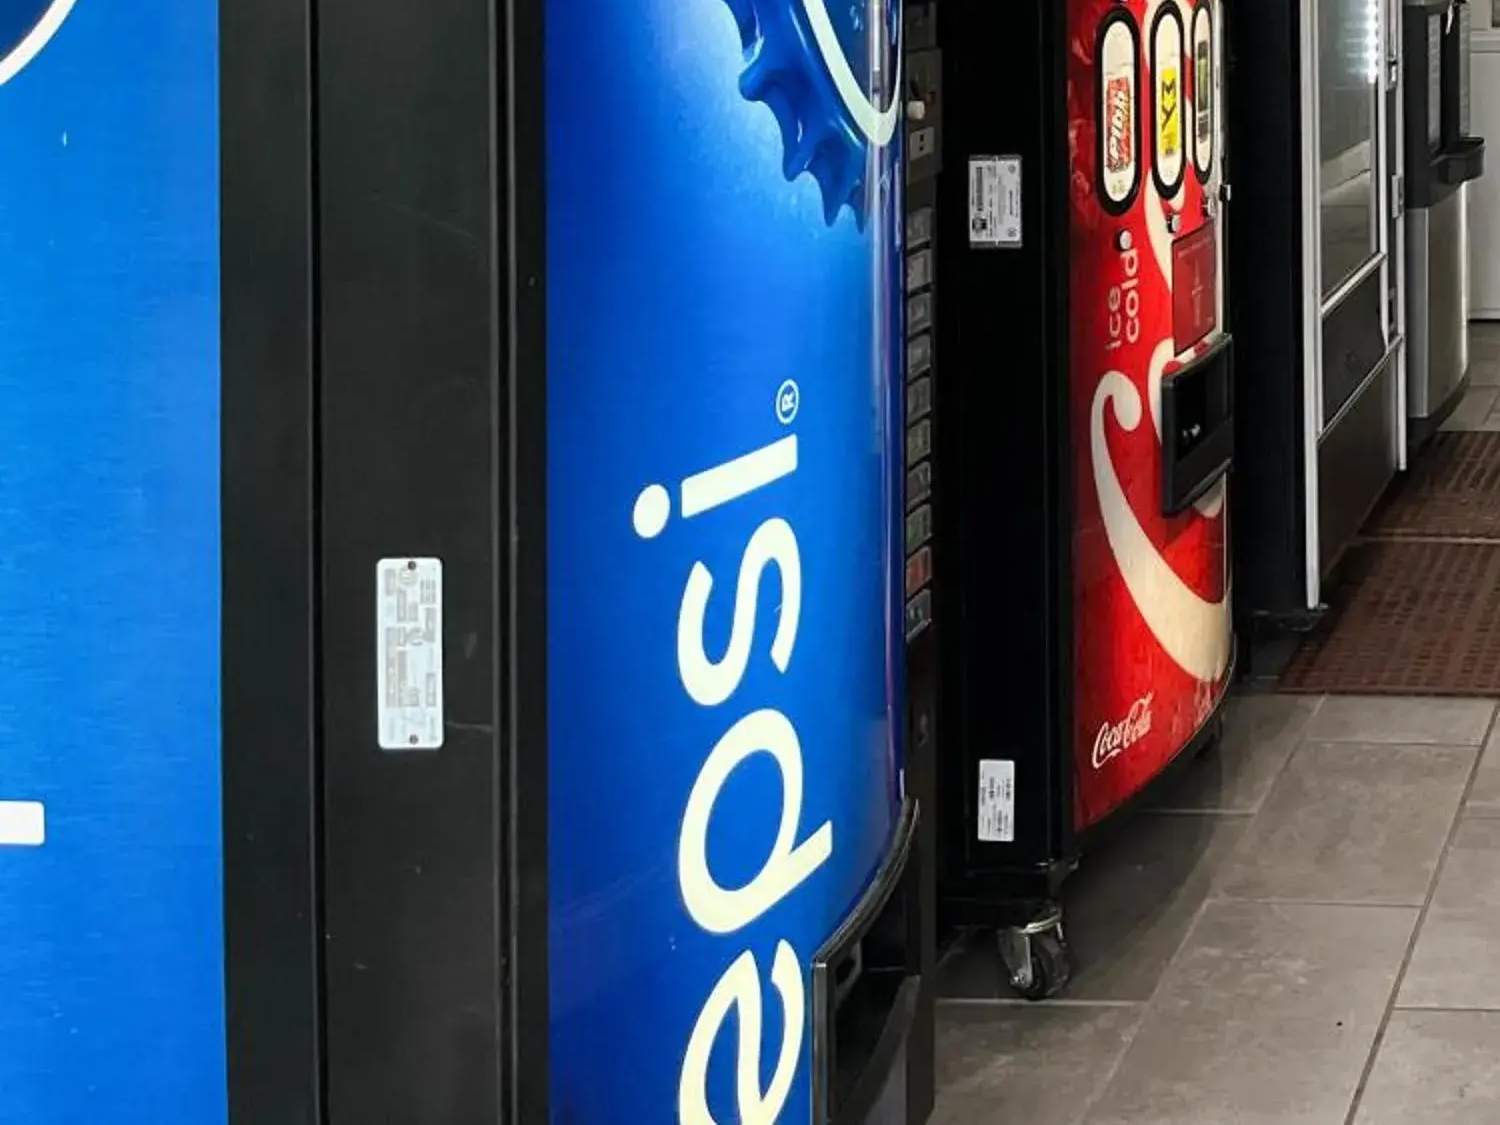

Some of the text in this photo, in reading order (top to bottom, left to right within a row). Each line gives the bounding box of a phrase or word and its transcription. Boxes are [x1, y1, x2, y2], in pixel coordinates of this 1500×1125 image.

[1105, 285, 1121, 350] ice
[1120, 248, 1140, 344] cold
[632, 433, 833, 1125] epsi
